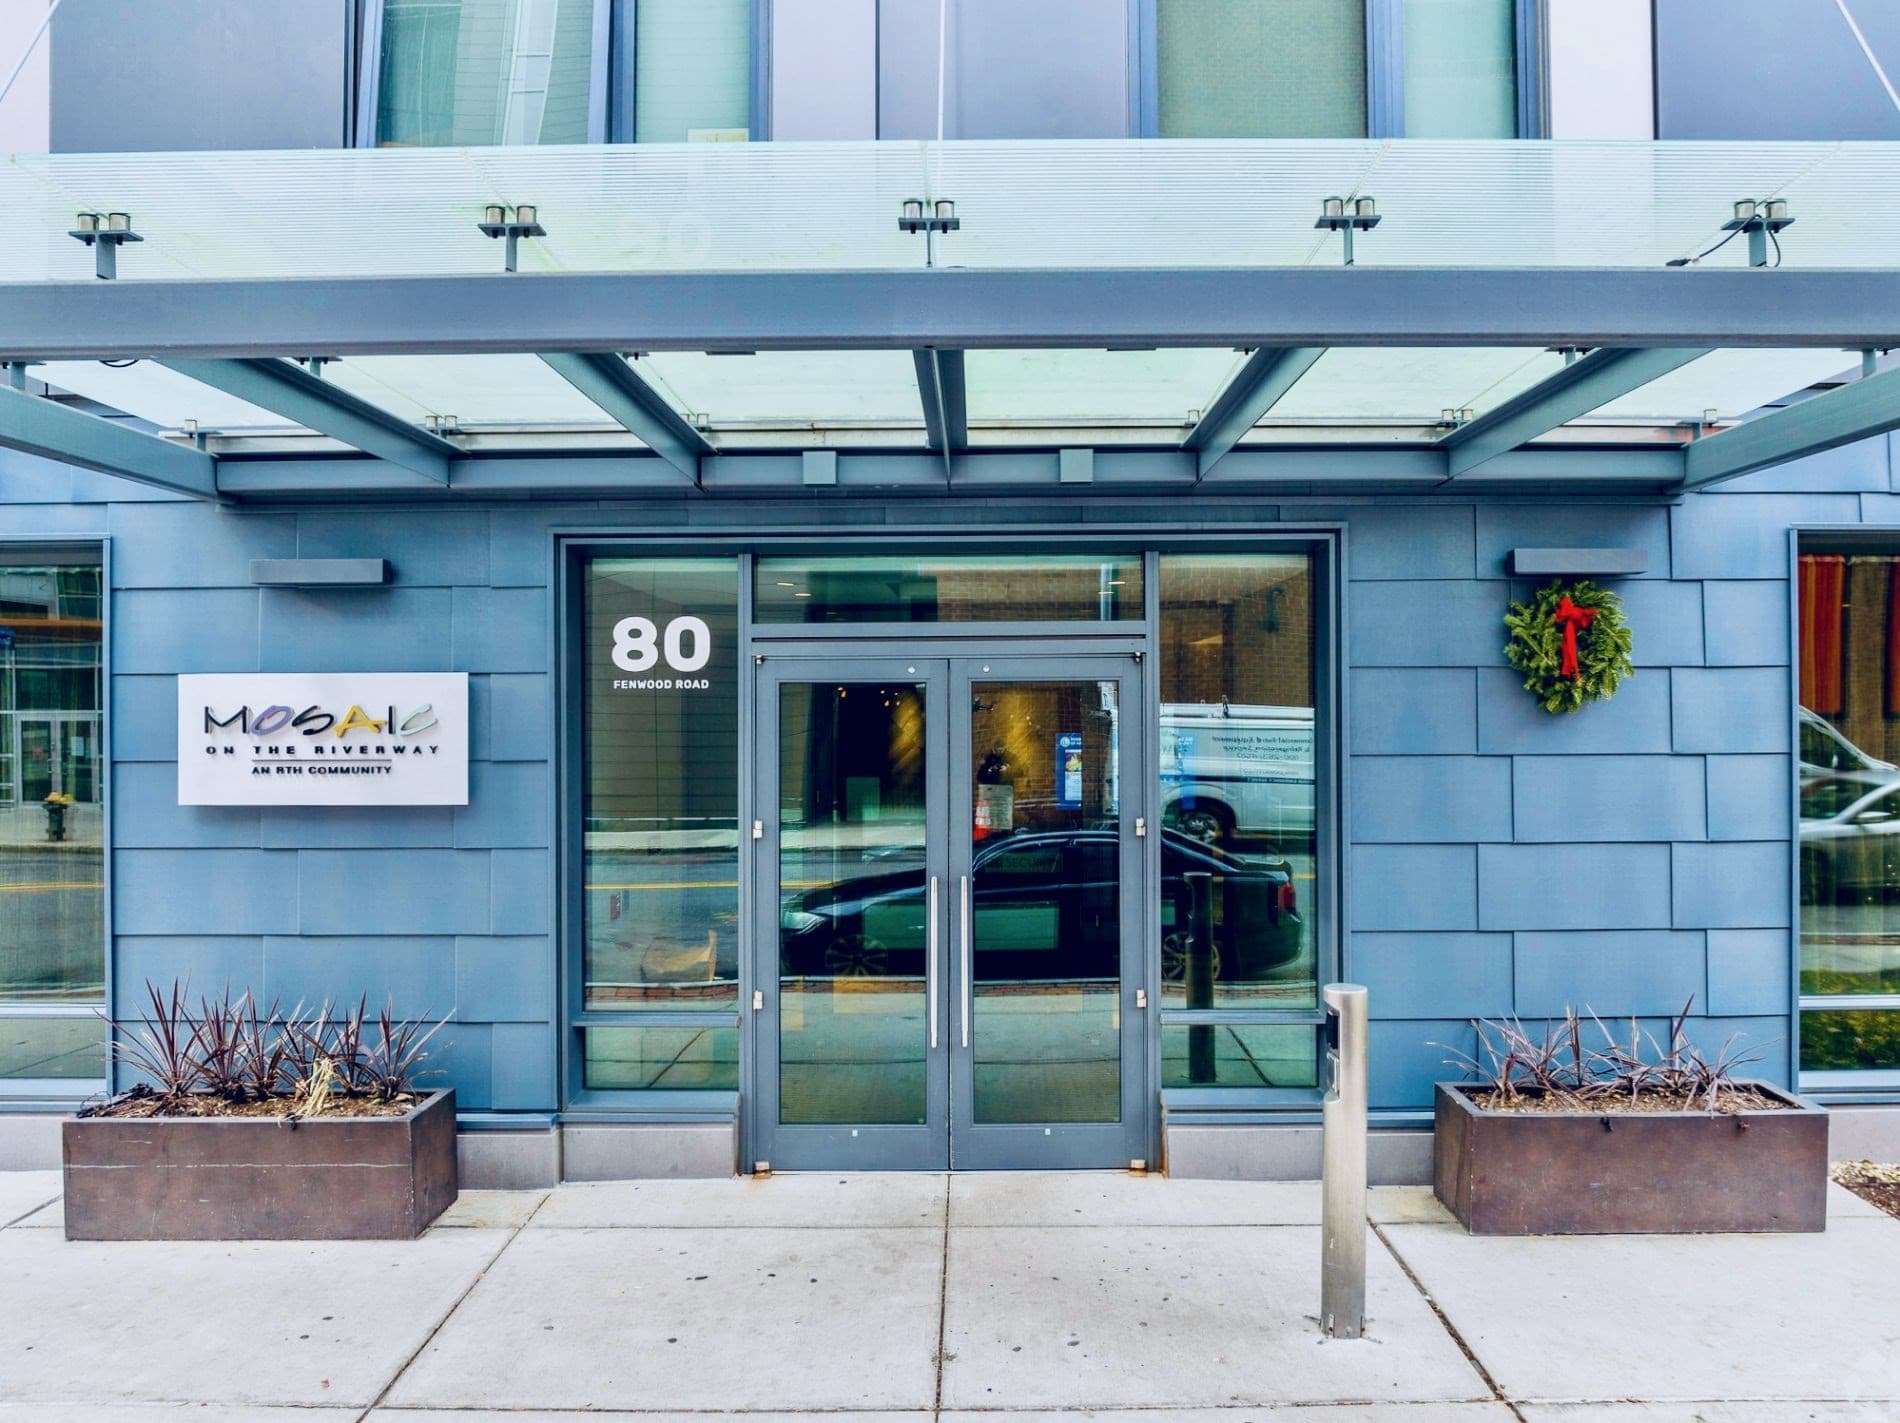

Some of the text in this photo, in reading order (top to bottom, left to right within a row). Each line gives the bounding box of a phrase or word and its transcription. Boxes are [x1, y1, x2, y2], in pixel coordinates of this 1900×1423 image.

[611, 616, 711, 672] 80
[613, 679, 710, 690] FENWOOD ROAD
[204, 704, 440, 738] MOSAIC
[205, 745, 439, 755] ON THE RIVERWAY
[251, 765, 392, 776] AN RTH COMMUNITY
